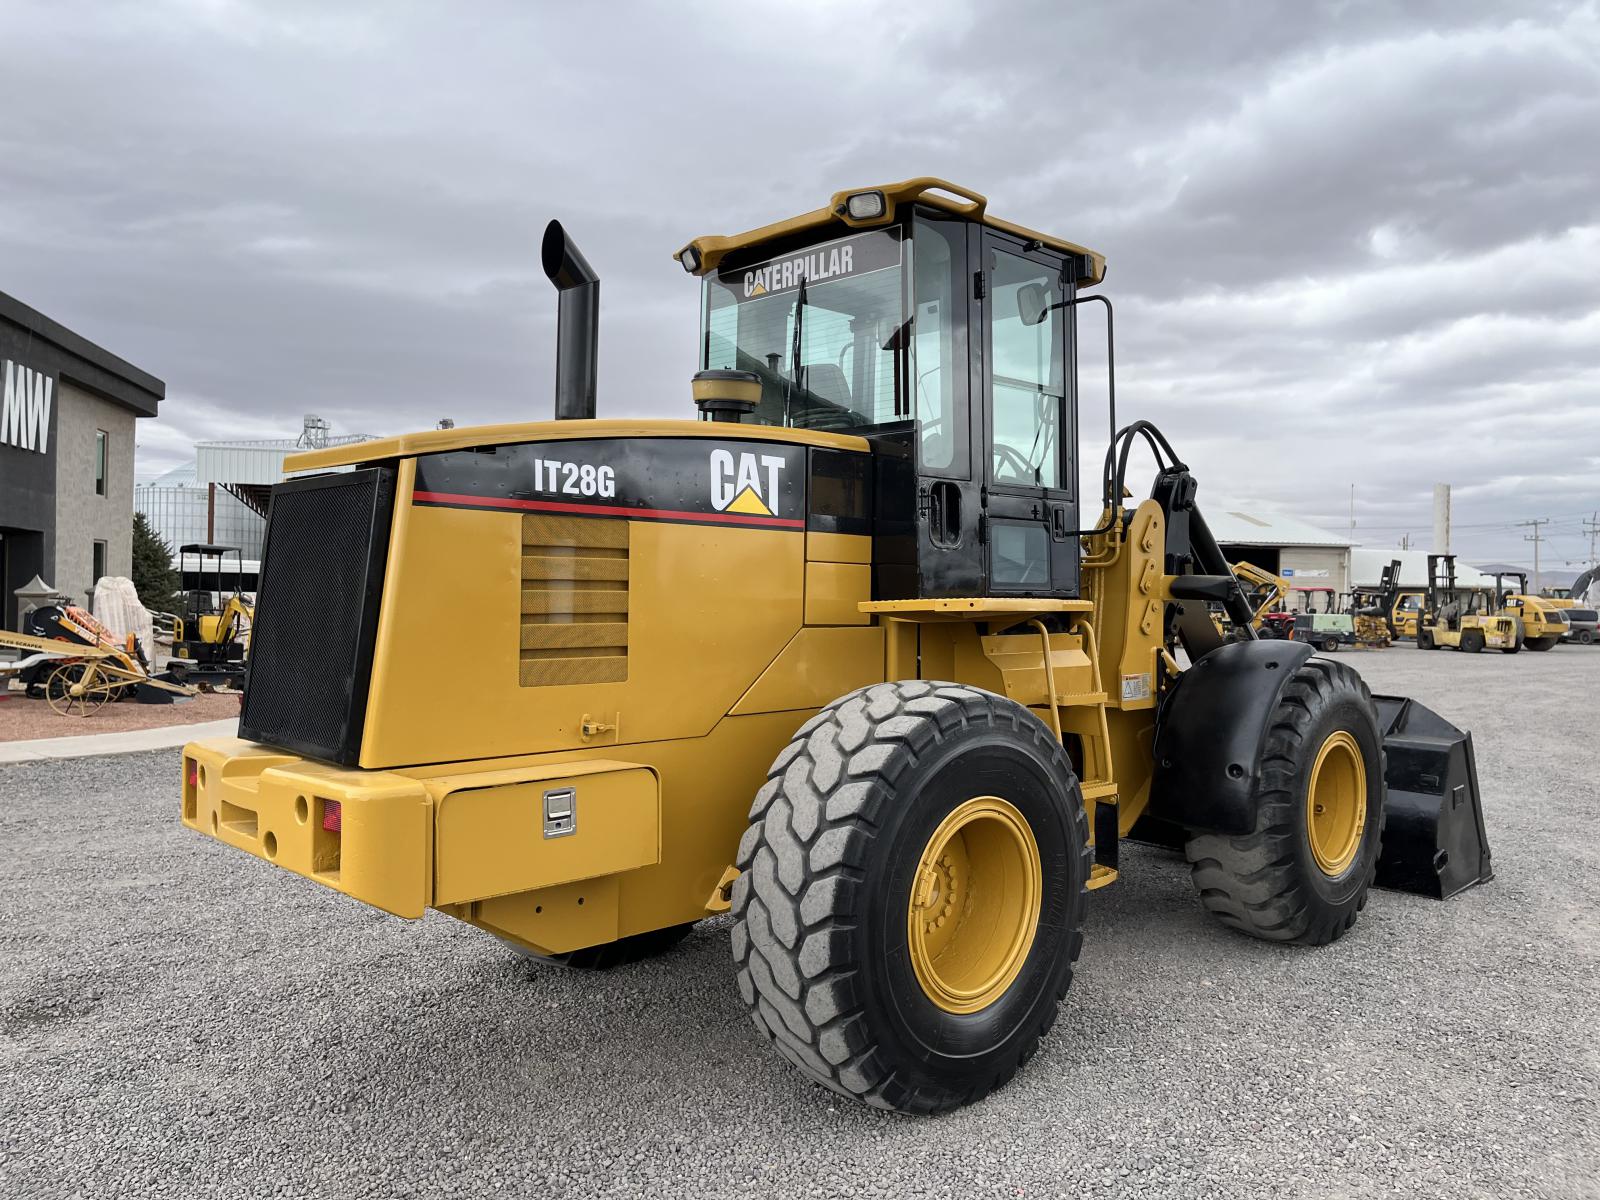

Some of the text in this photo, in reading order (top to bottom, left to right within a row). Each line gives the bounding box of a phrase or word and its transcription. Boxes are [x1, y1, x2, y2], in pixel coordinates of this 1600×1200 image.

[743, 245, 853, 298] CATERPILLAR
[0, 359, 53, 454] MW
[534, 458, 615, 498] IT28G
[710, 449, 786, 517] CAT
[16, 640, 42, 648] SCRAPER
